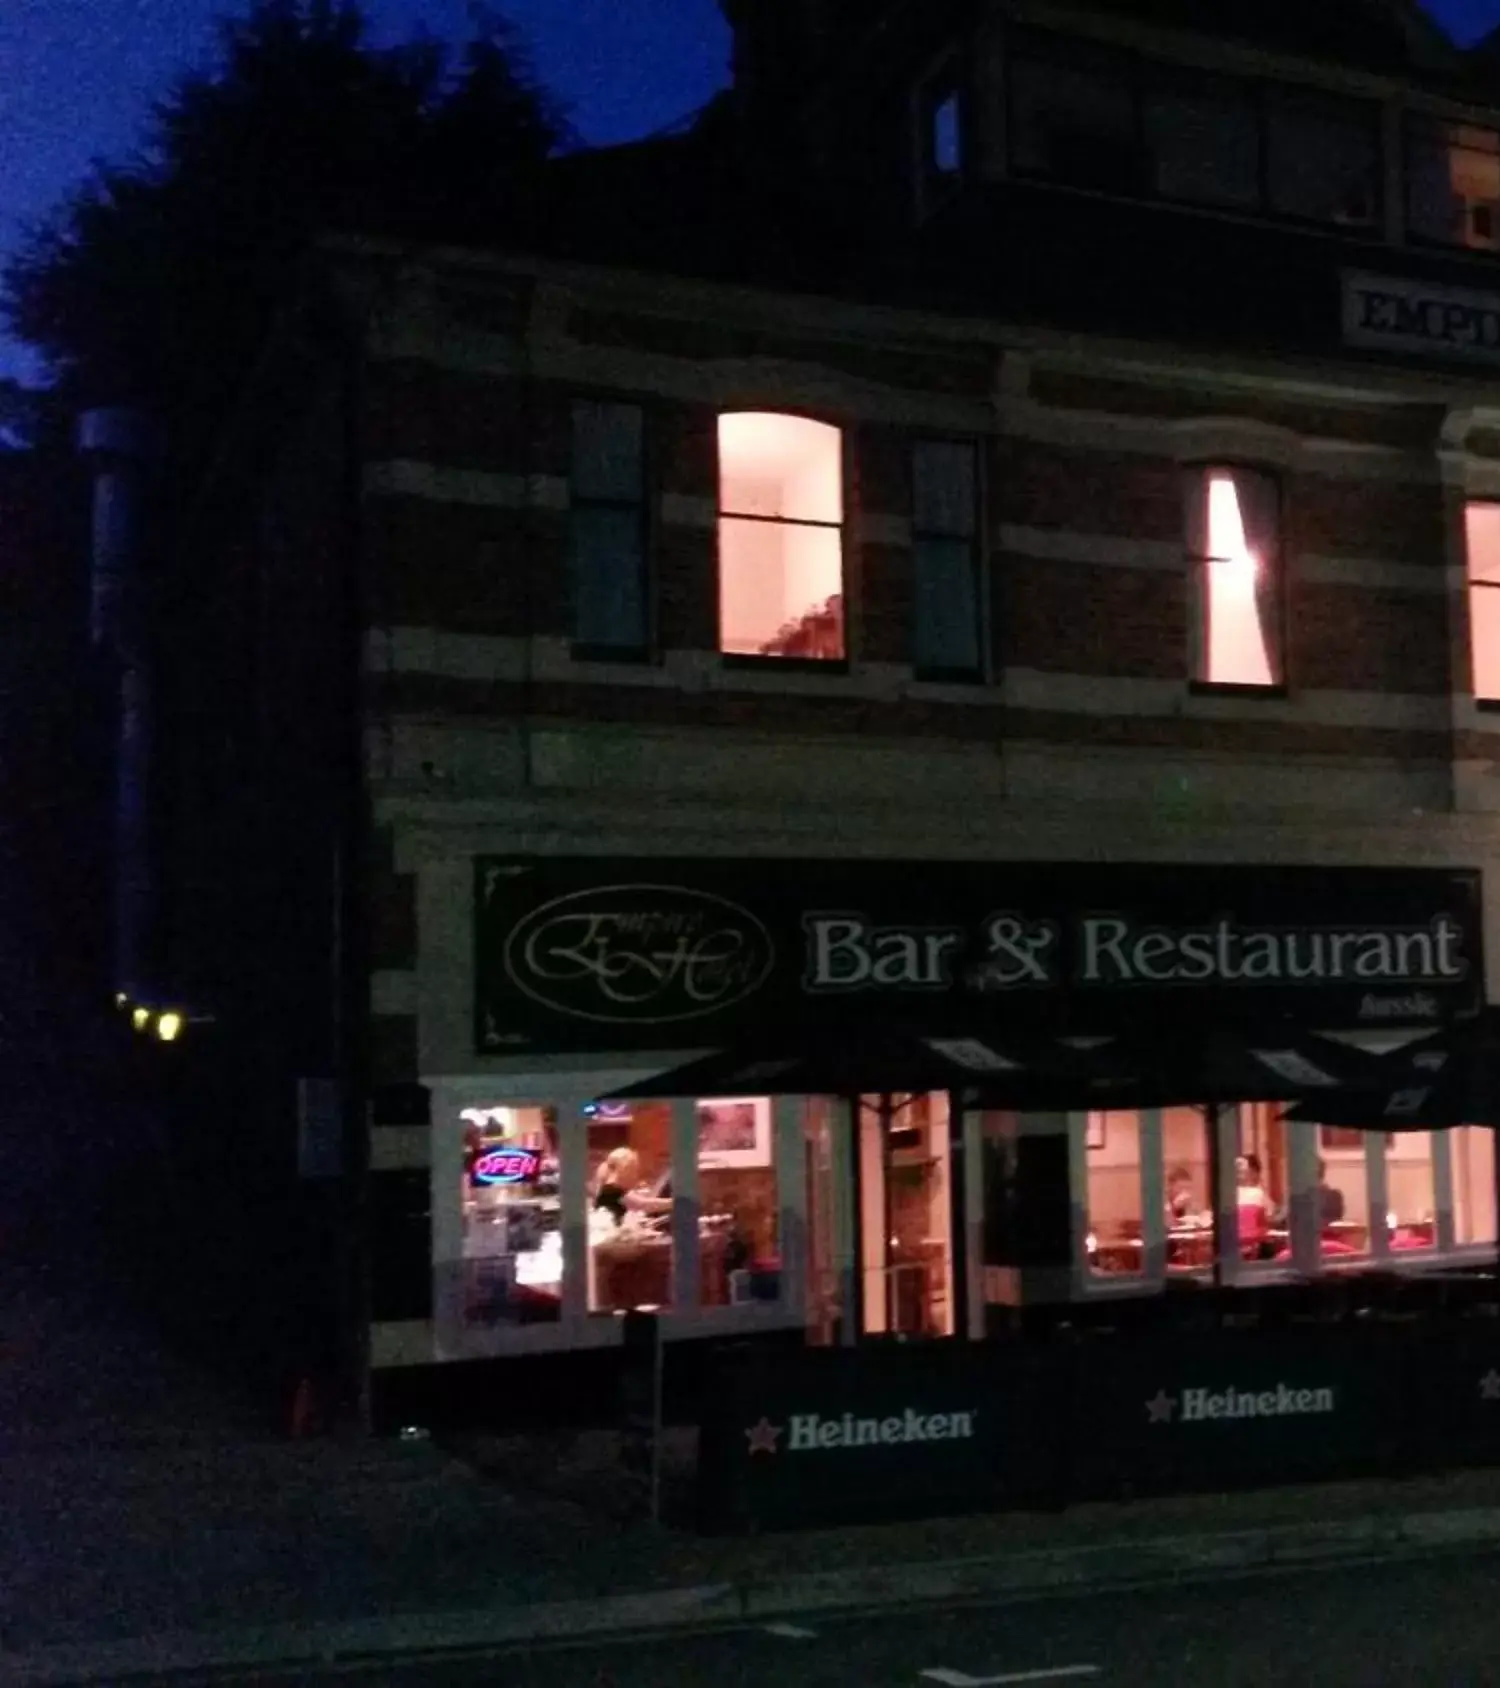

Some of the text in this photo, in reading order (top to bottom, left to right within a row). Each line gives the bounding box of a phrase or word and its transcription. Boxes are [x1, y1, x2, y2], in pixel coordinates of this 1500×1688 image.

[810, 917, 960, 987] Bar
[987, 916, 1054, 982] &
[1081, 917, 1463, 981] Restaurant
[474, 1157, 538, 1174] OPEN
[1179, 1384, 1335, 1422] Heineken
[787, 1406, 977, 1451] Heineken
